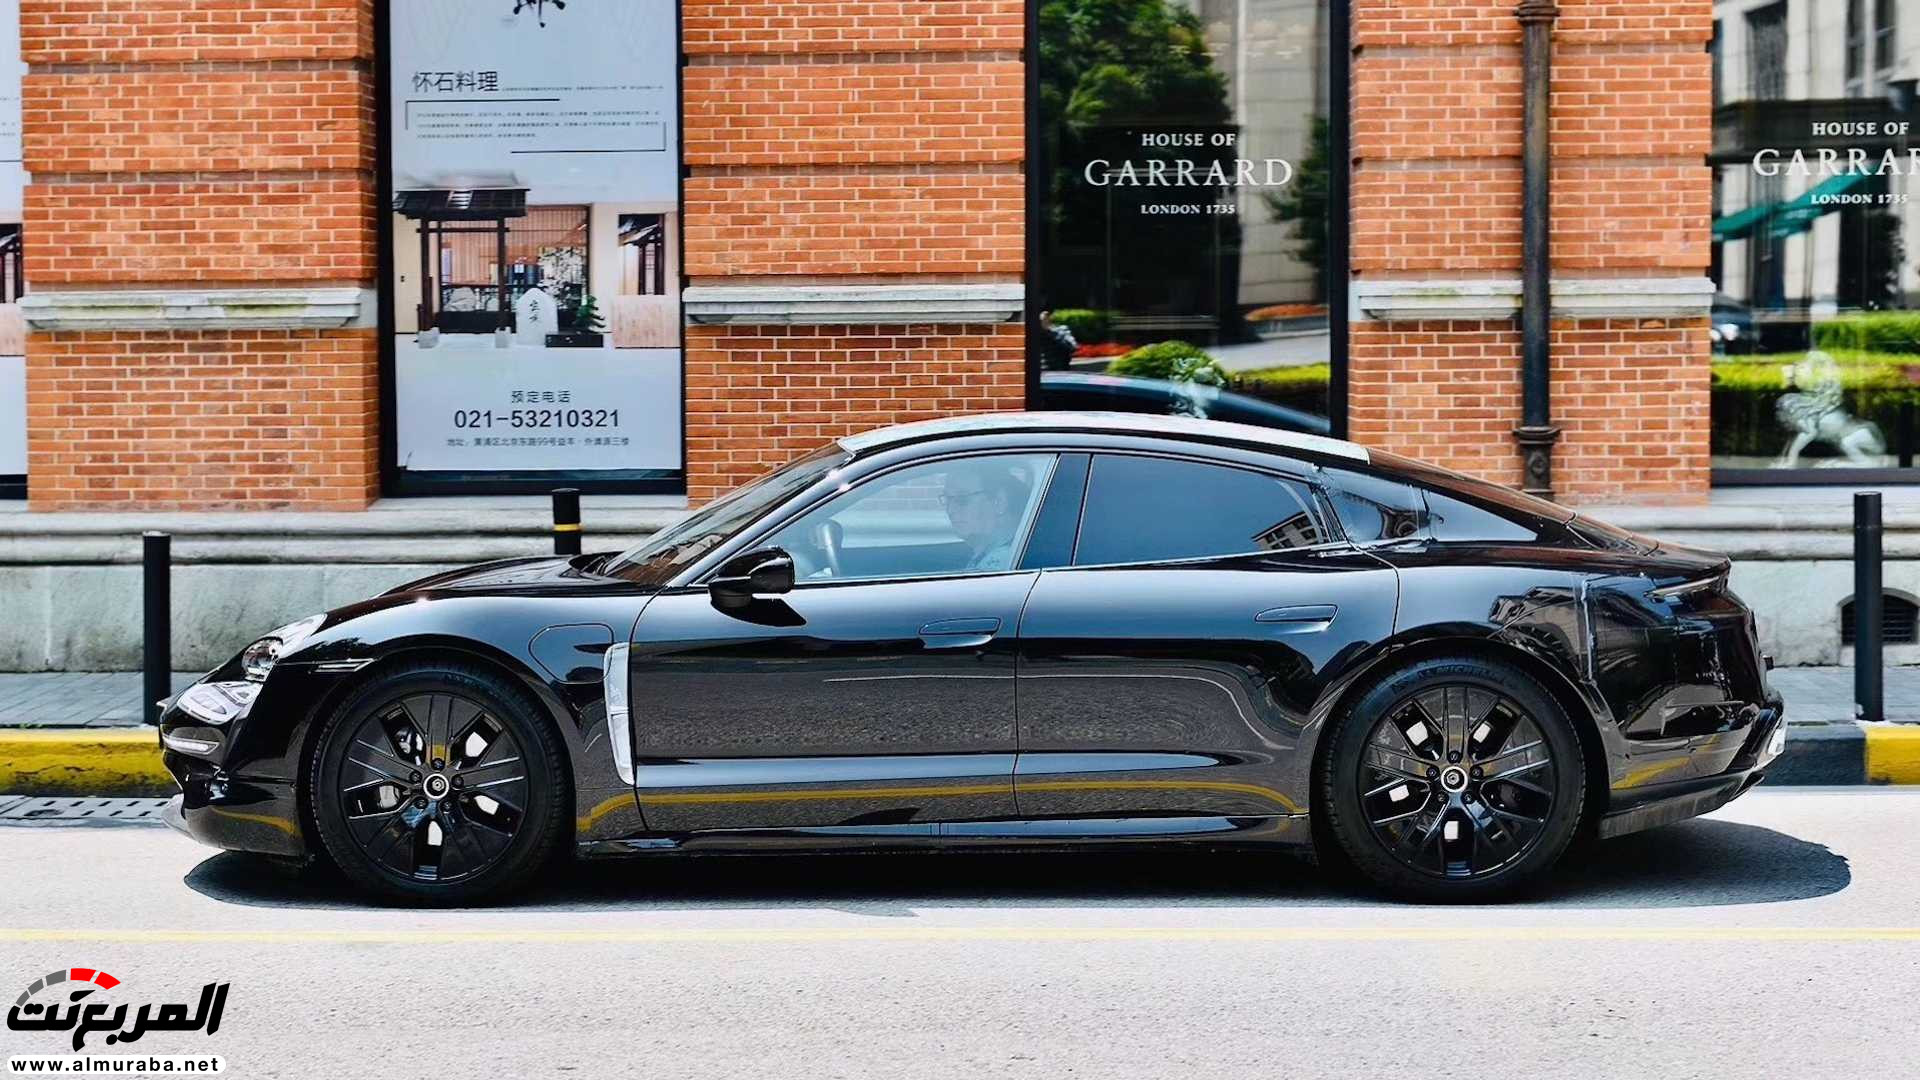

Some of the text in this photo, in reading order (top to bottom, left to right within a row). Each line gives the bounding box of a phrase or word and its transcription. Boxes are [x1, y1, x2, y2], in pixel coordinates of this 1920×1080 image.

[412, 71, 499, 93] 怀石料理
[1812, 122, 1910, 136] HOUSE OF
[1141, 133, 1236, 147] HOUSE OF
[1084, 158, 1293, 187] GARRARD
[1811, 194, 1909, 205] LONDON 1735
[1140, 204, 1236, 215] LONDON 1735
[511, 390, 572, 404] 预定电话
[454, 409, 620, 429] 021-53210321
